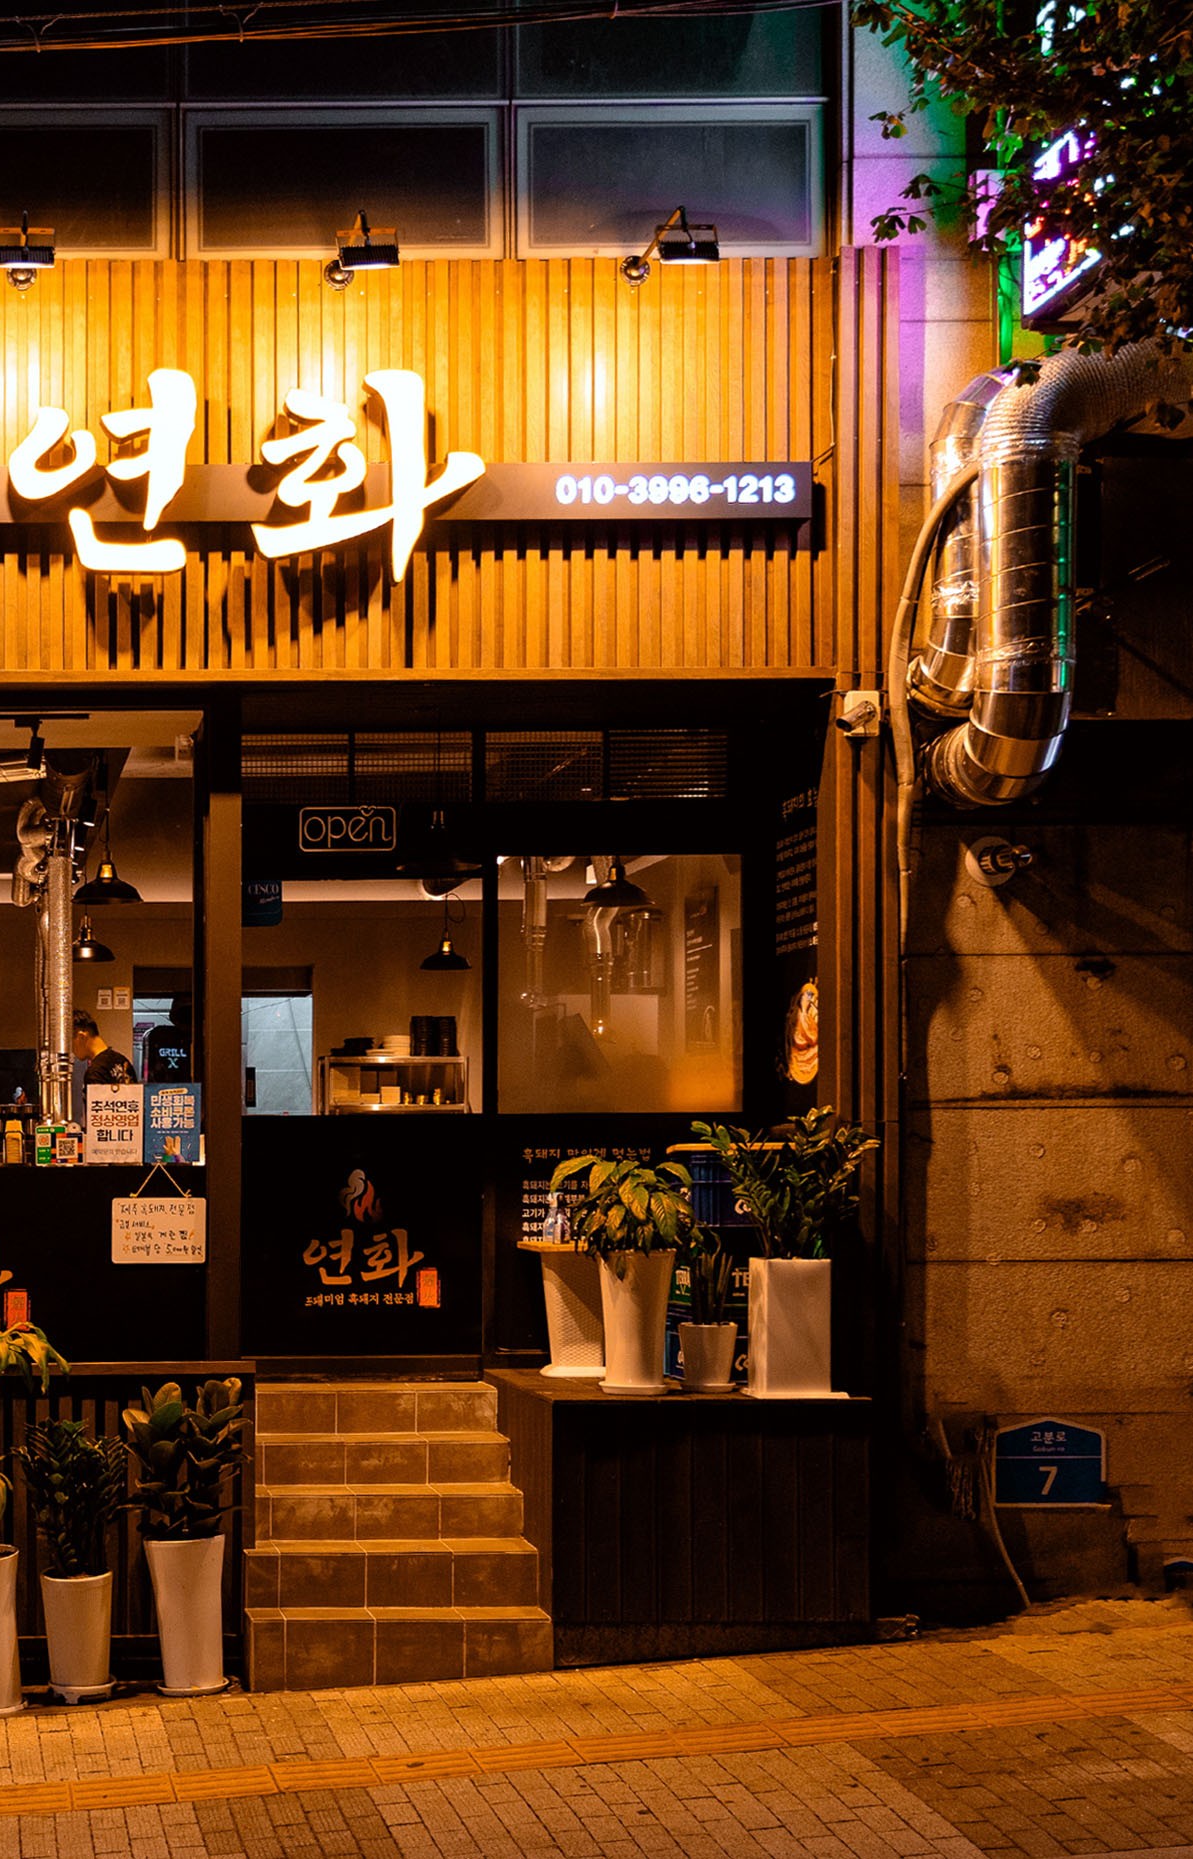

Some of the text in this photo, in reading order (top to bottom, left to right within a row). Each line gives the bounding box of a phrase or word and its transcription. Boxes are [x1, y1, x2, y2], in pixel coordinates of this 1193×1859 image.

[8, 368, 487, 583] 연화
[555, 473, 796, 505] 010-3996-1213
[304, 815, 393, 849] open
[158, 1047, 188, 1058] GRILL
[90, 1100, 140, 1113] 추석연휴
[90, 1114, 140, 1128] 정상영업
[150, 1117, 195, 1129] 사용가능
[96, 1129, 134, 1142] 합니다
[521, 1147, 561, 1165] 흑돼지
[521, 1208, 546, 1218] 고기가
[303, 1228, 425, 1289] 연화
[348, 1292, 379, 1306] 흑돼지
[383, 1291, 414, 1305] 전문점
[1038, 1465, 1059, 1496] 7
